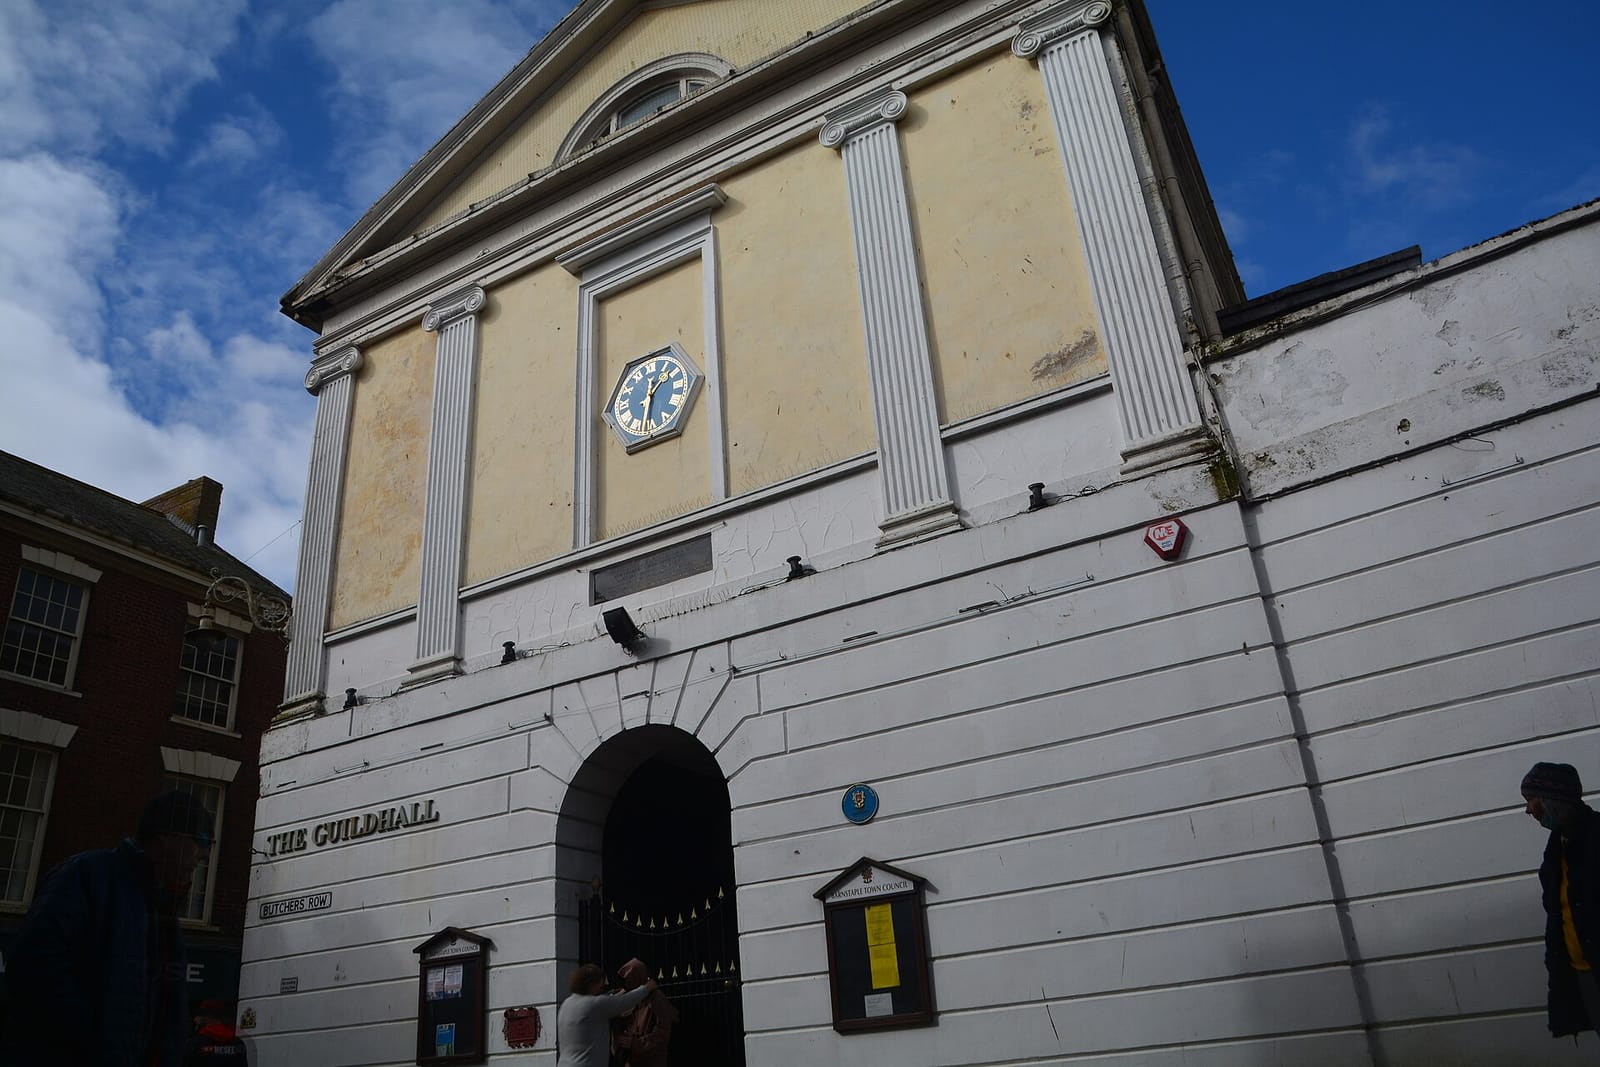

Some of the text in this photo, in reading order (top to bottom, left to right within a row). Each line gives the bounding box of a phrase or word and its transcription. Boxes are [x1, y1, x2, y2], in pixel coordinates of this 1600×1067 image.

[266, 800, 441, 857] THE GUILDHALL
[864, 885, 882, 895] TOWN
[882, 881, 909, 892] COUNCIL
[263, 895, 328, 917] BUTCHERS ROW
